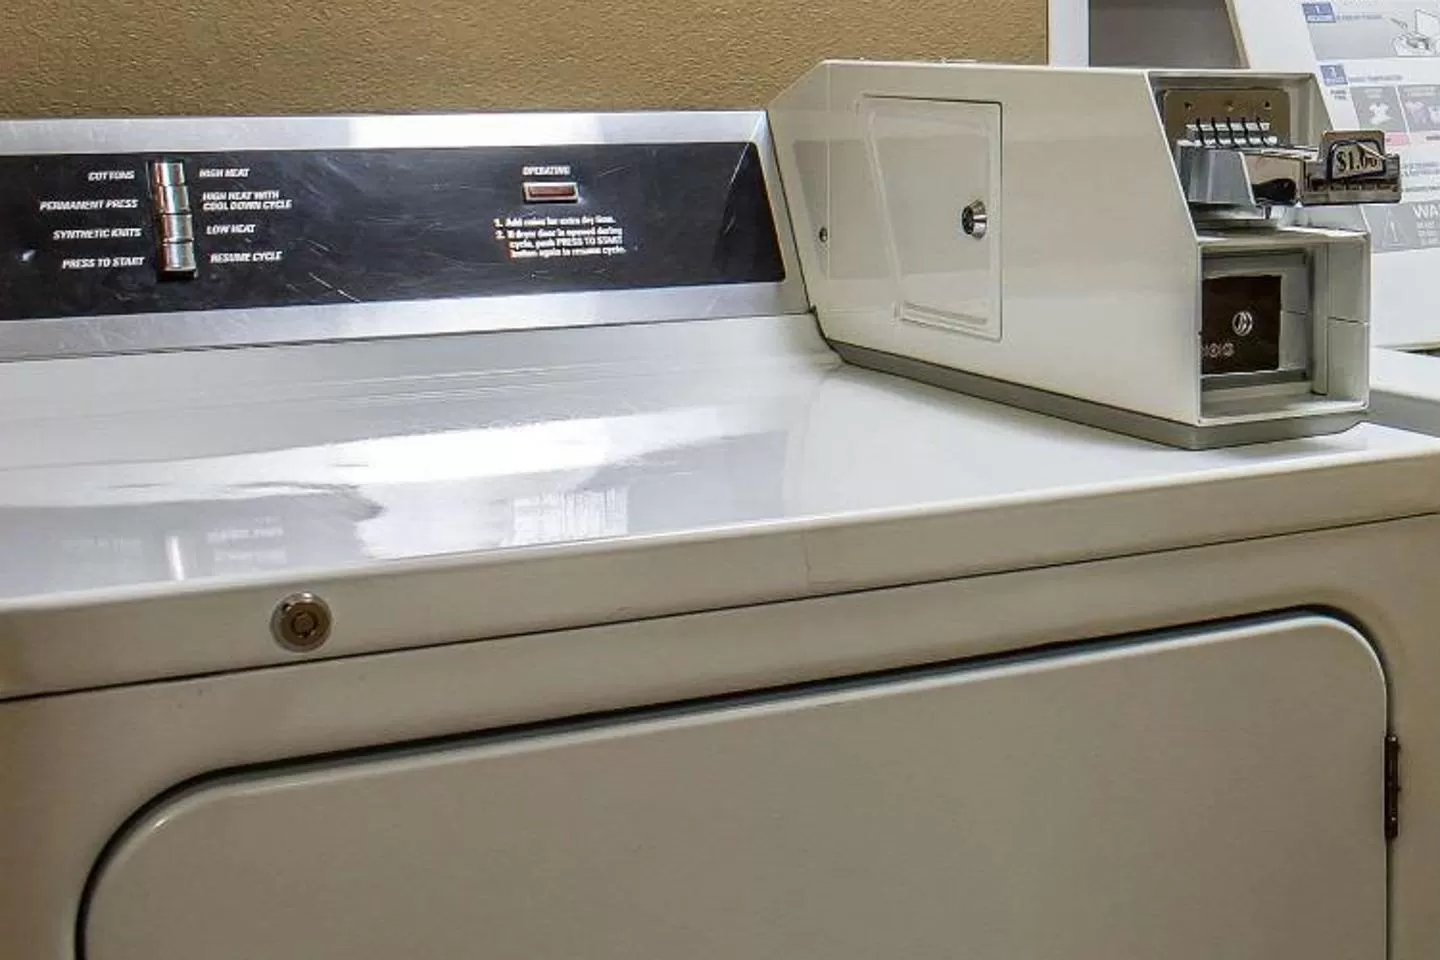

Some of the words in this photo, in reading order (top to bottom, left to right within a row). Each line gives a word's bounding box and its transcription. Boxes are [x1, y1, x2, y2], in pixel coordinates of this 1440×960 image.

[88, 171, 135, 181] COTTONS
[199, 169, 223, 178] HIGH
[224, 168, 250, 178] HEAT
[522, 165, 571, 176] OPERATING
[203, 191, 227, 201] HIGH
[228, 191, 253, 200] HEAT
[254, 189, 280, 200] WITH
[40, 200, 104, 211] PERMANENT
[105, 199, 139, 209] PRESS
[203, 201, 229, 211] COOL
[230, 200, 262, 210] DOWN
[263, 199, 293, 209] CYCLE
[53, 228, 110, 240] SYNTHETIC
[111, 228, 142, 238] KNITS
[206, 224, 231, 235] LOW
[231, 224, 256, 234] HEAT
[62, 258, 96, 269] PRESS
[97, 257, 111, 268] TO
[112, 257, 145, 267] START
[210, 252, 251, 263] RESUME
[252, 251, 283, 262] CYCLE
